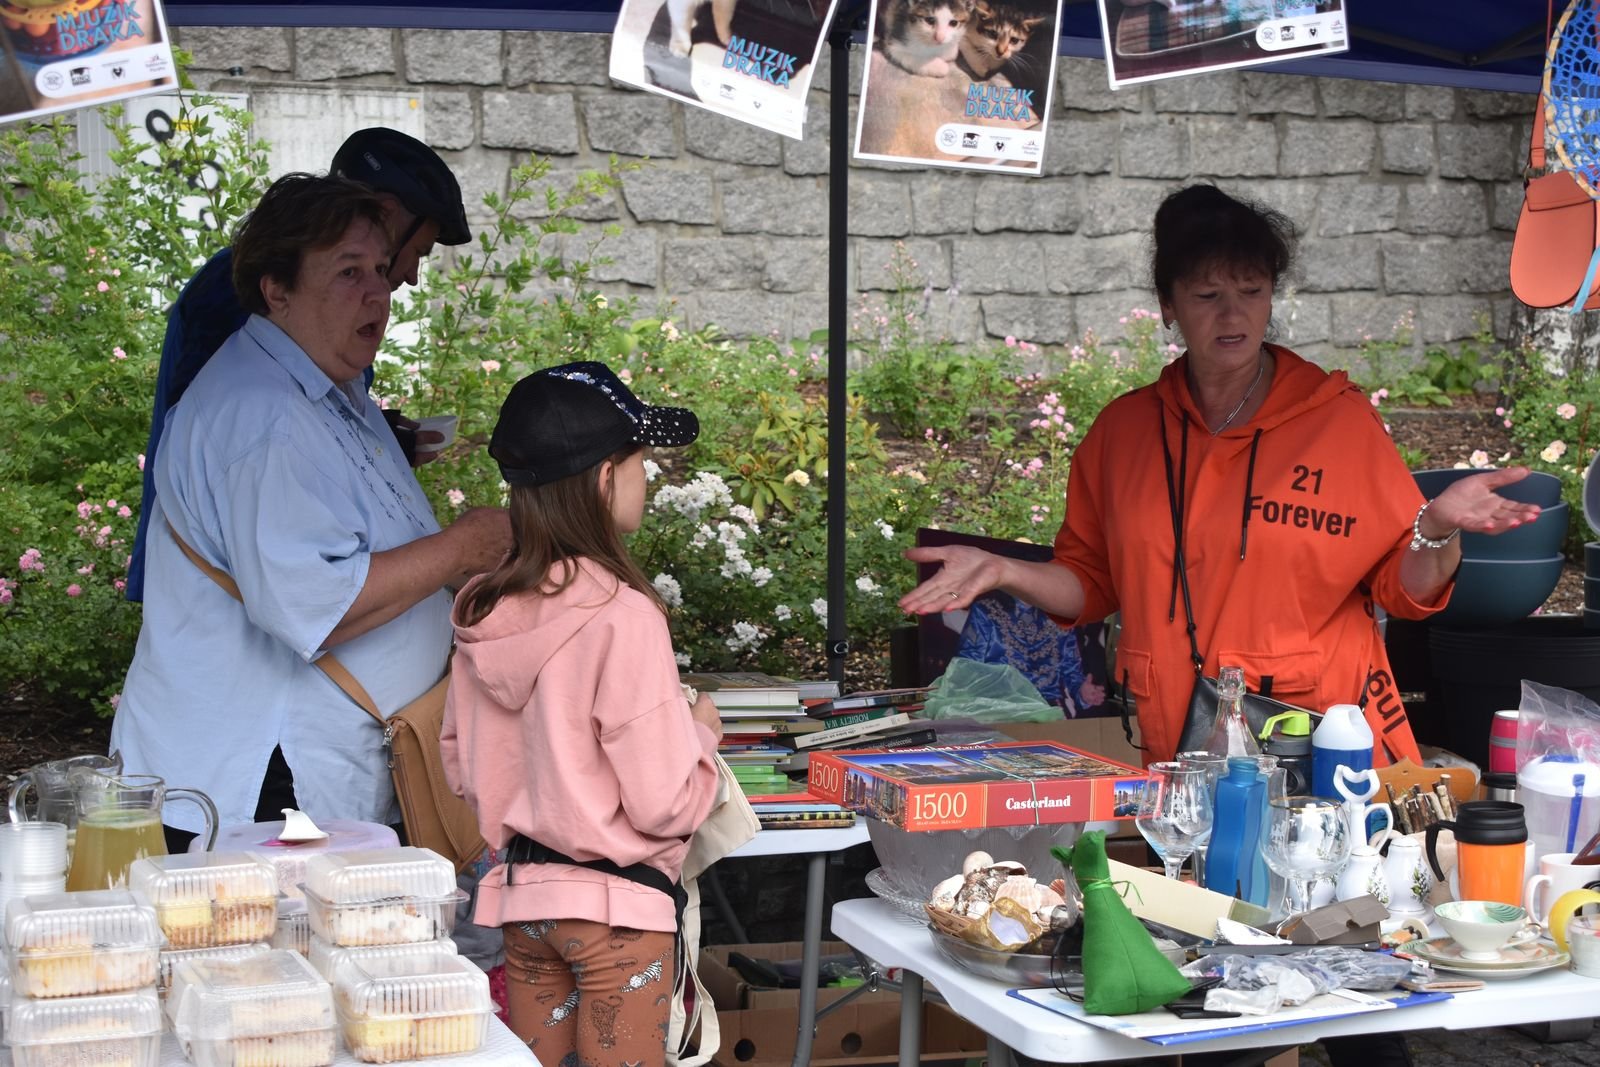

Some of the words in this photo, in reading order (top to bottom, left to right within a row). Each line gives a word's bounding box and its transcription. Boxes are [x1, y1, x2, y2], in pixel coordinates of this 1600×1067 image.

[56, 0, 142, 32] MJUZIK
[59, 19, 145, 51] DRAKA
[722, 50, 790, 90] DRAKA
[727, 35, 798, 74] MJUZIK
[964, 98, 1031, 122] DRAKA
[967, 82, 1035, 106] MJUZIK
[1291, 464, 1324, 496] 21
[1245, 495, 1357, 538] Forever
[839, 712, 870, 728] KOBIETY
[810, 760, 839, 793] 1500
[913, 791, 968, 820] 1500
[1005, 795, 1072, 811] Castorland
